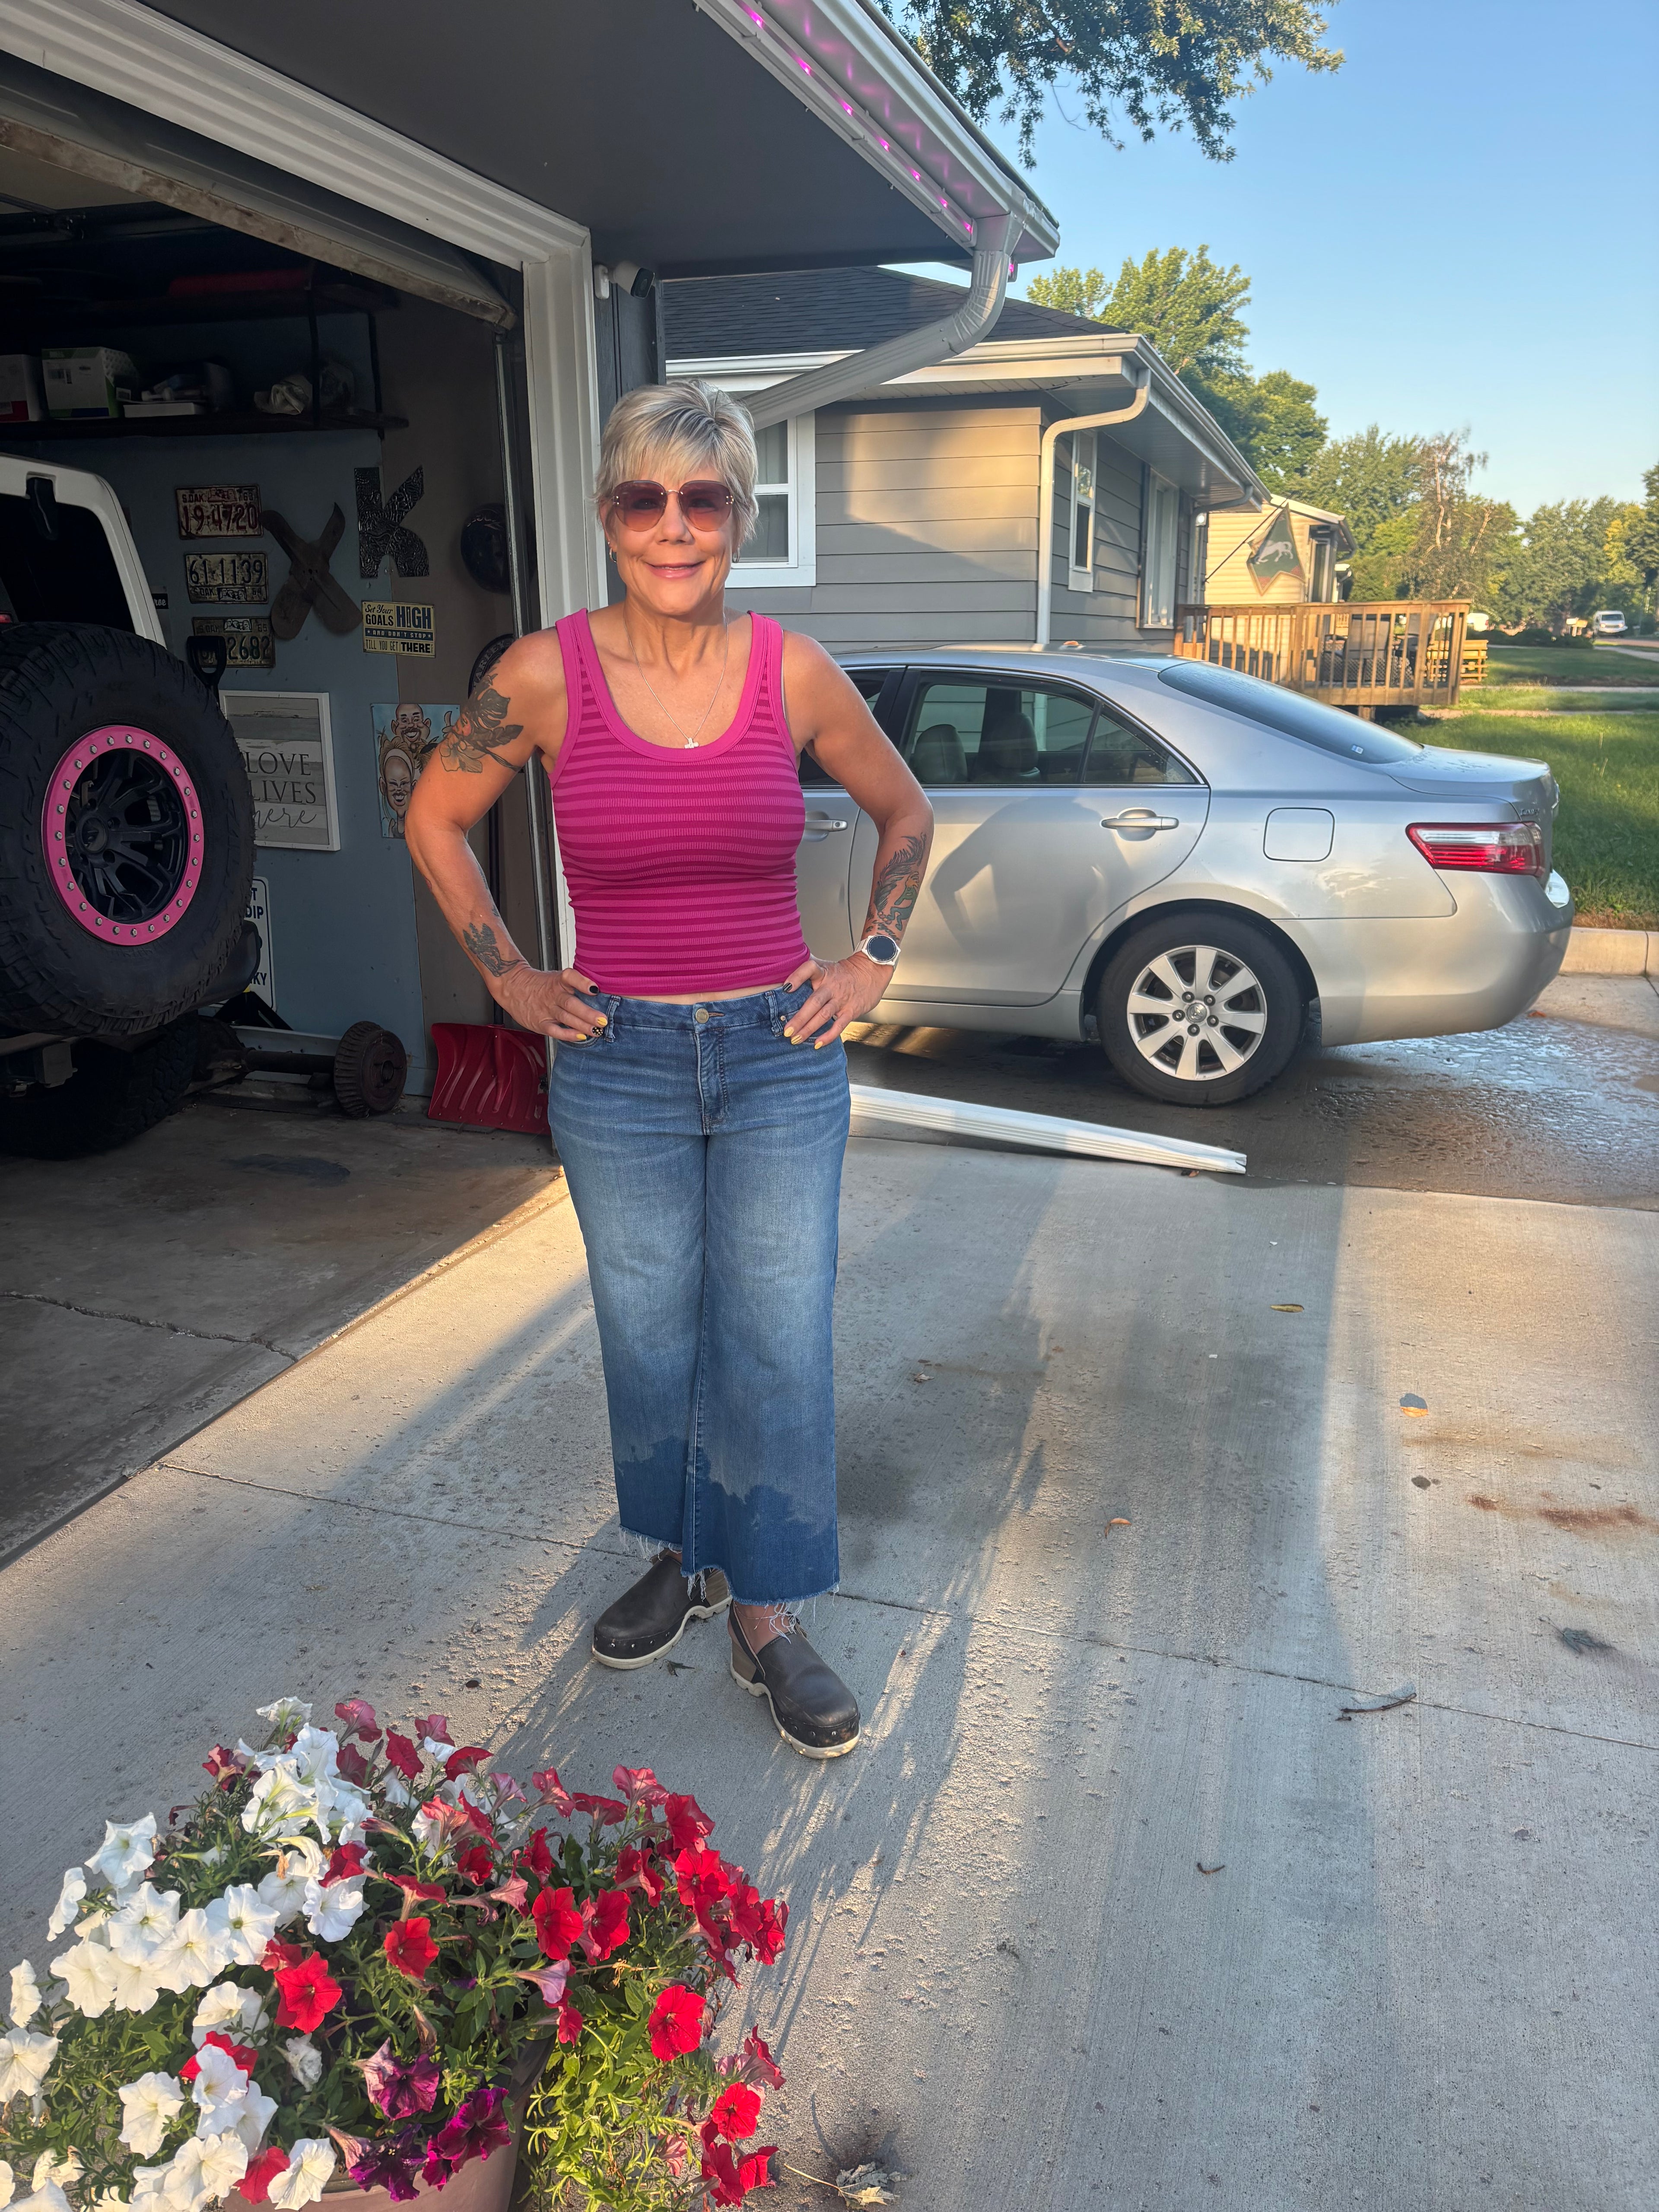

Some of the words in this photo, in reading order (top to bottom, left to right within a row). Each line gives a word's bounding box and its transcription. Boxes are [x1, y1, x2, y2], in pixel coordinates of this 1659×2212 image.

[365, 604, 375, 613] Set
[376, 604, 393, 614] Your
[396, 606, 431, 629] HIGH
[365, 614, 394, 626] GOALS
[365, 639, 376, 650] TILL
[379, 640, 388, 650] YOU
[390, 641, 398, 651] GET
[401, 642, 430, 653] THERE
[245, 752, 311, 775] LOVE
[248, 780, 316, 804] LIVES
